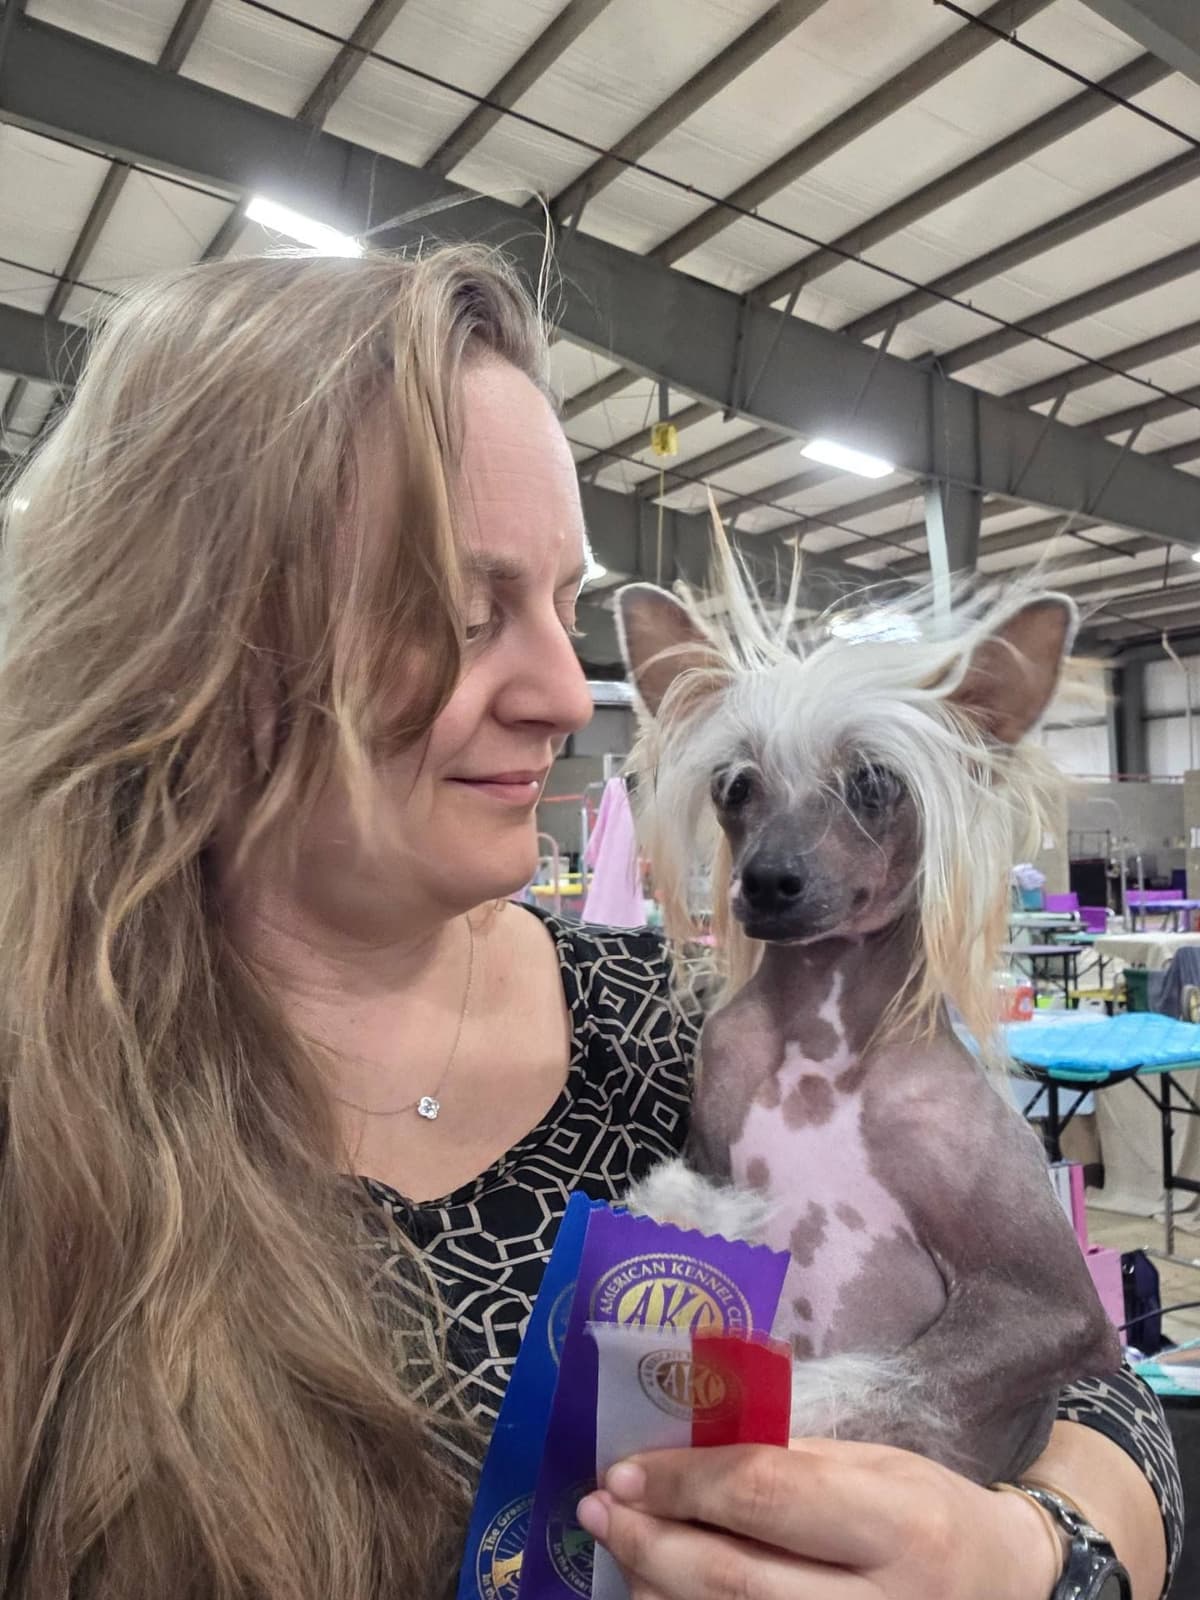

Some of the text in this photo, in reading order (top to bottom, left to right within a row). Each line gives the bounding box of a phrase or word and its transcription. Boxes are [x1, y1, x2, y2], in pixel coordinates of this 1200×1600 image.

[600, 1260, 743, 1338] AMERICAN KENNEL CLU
[482, 1527, 501, 1552] The
